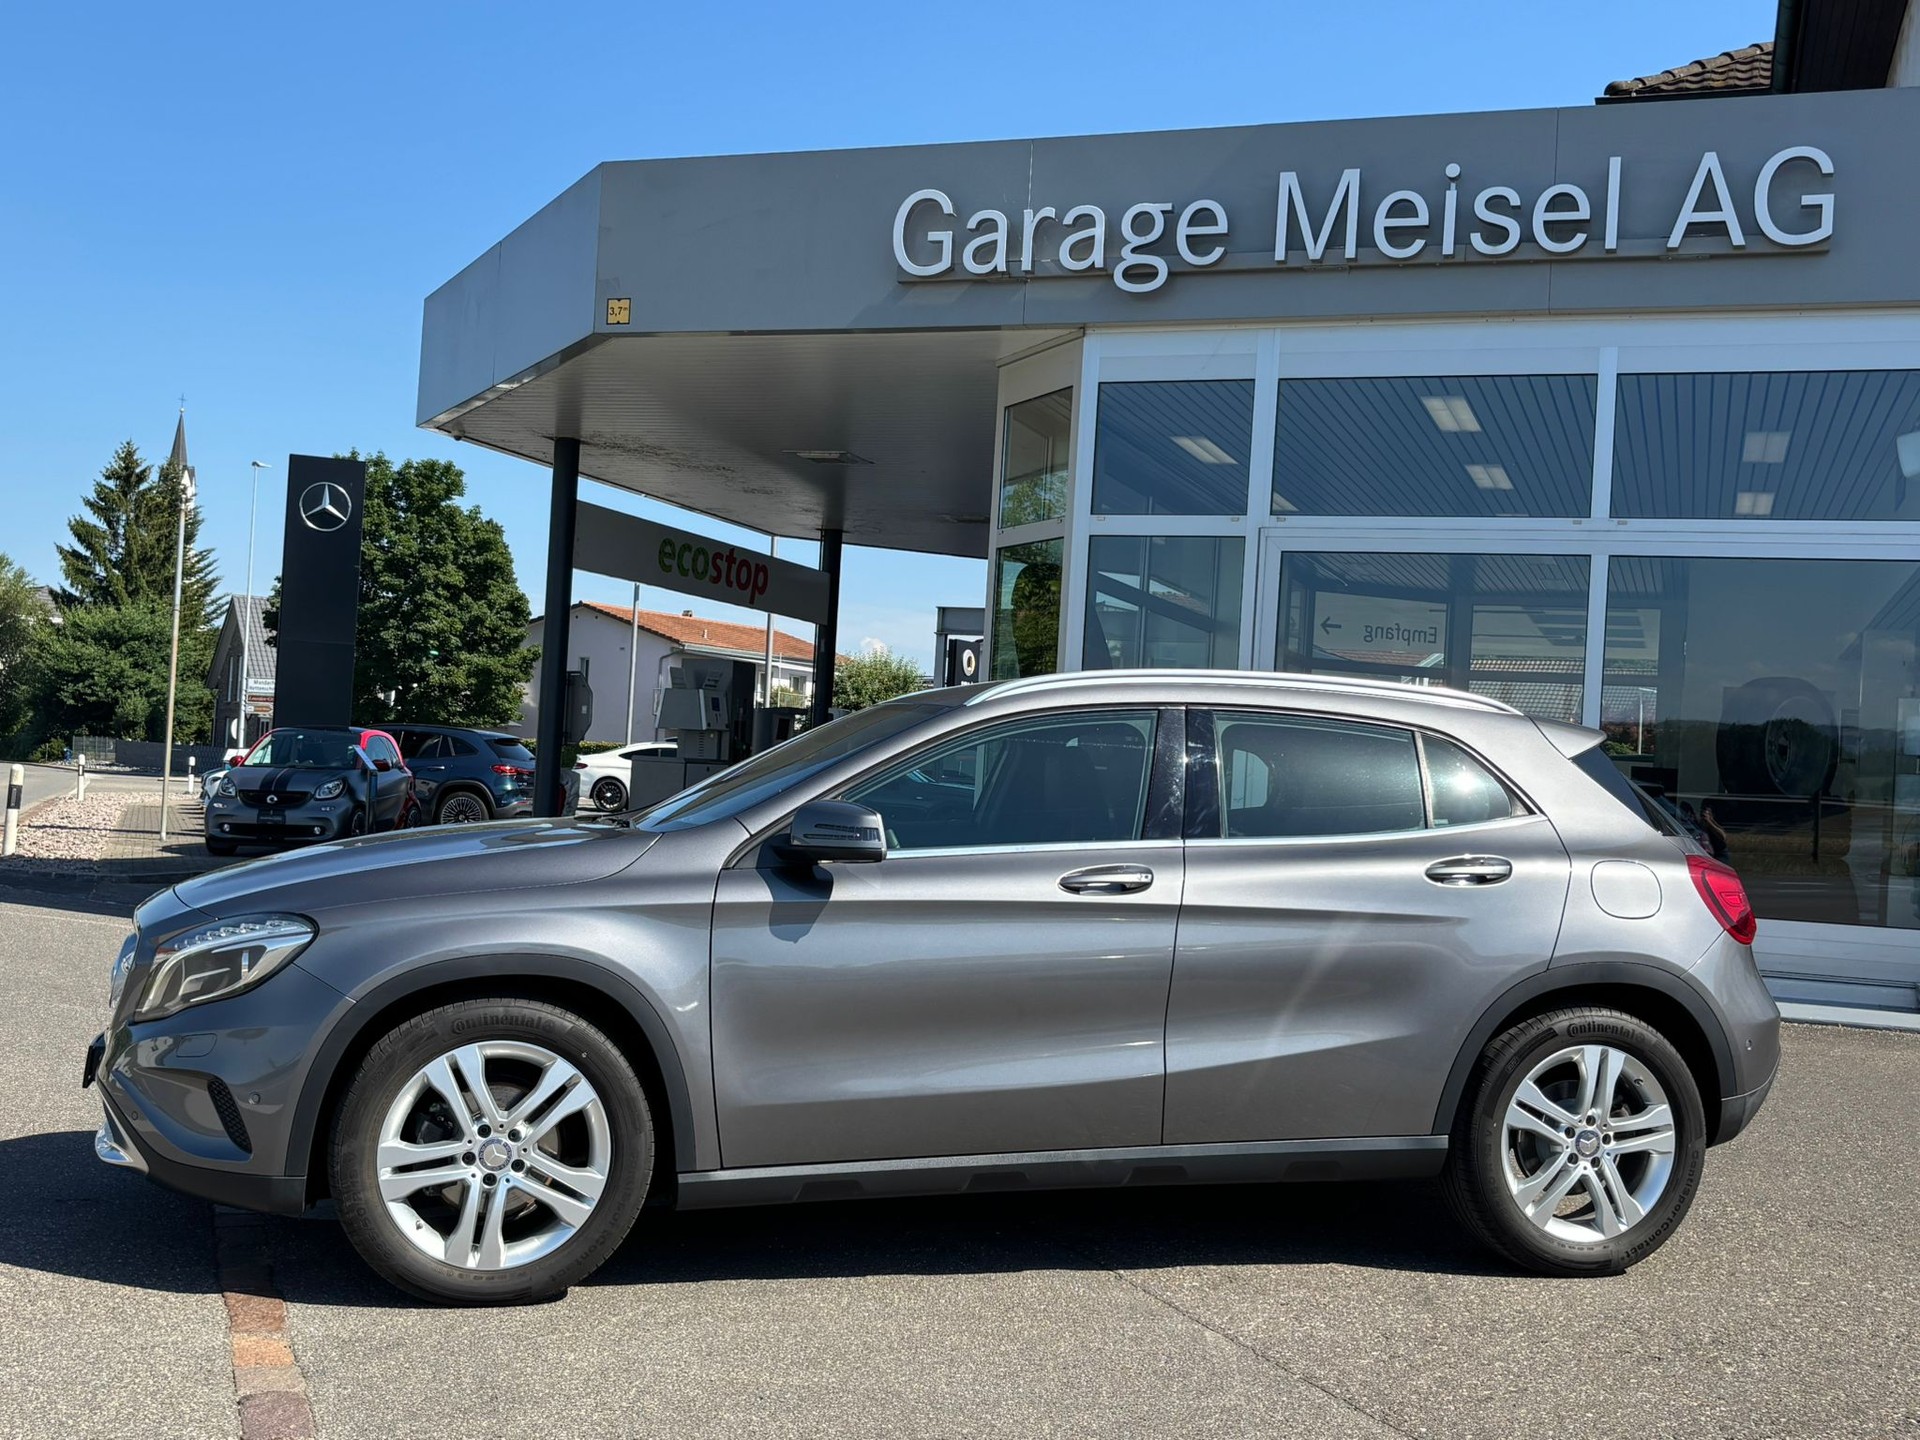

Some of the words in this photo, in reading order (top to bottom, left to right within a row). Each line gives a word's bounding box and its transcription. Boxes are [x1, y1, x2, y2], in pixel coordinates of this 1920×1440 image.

[893, 188, 1229, 293] Garage
[1274, 156, 1622, 262] Meisel
[1666, 146, 1835, 249] AG
[658, 538, 769, 605] ecostop
[450, 1013, 543, 1034] Continental
[1566, 1021, 1637, 1038] Continental
